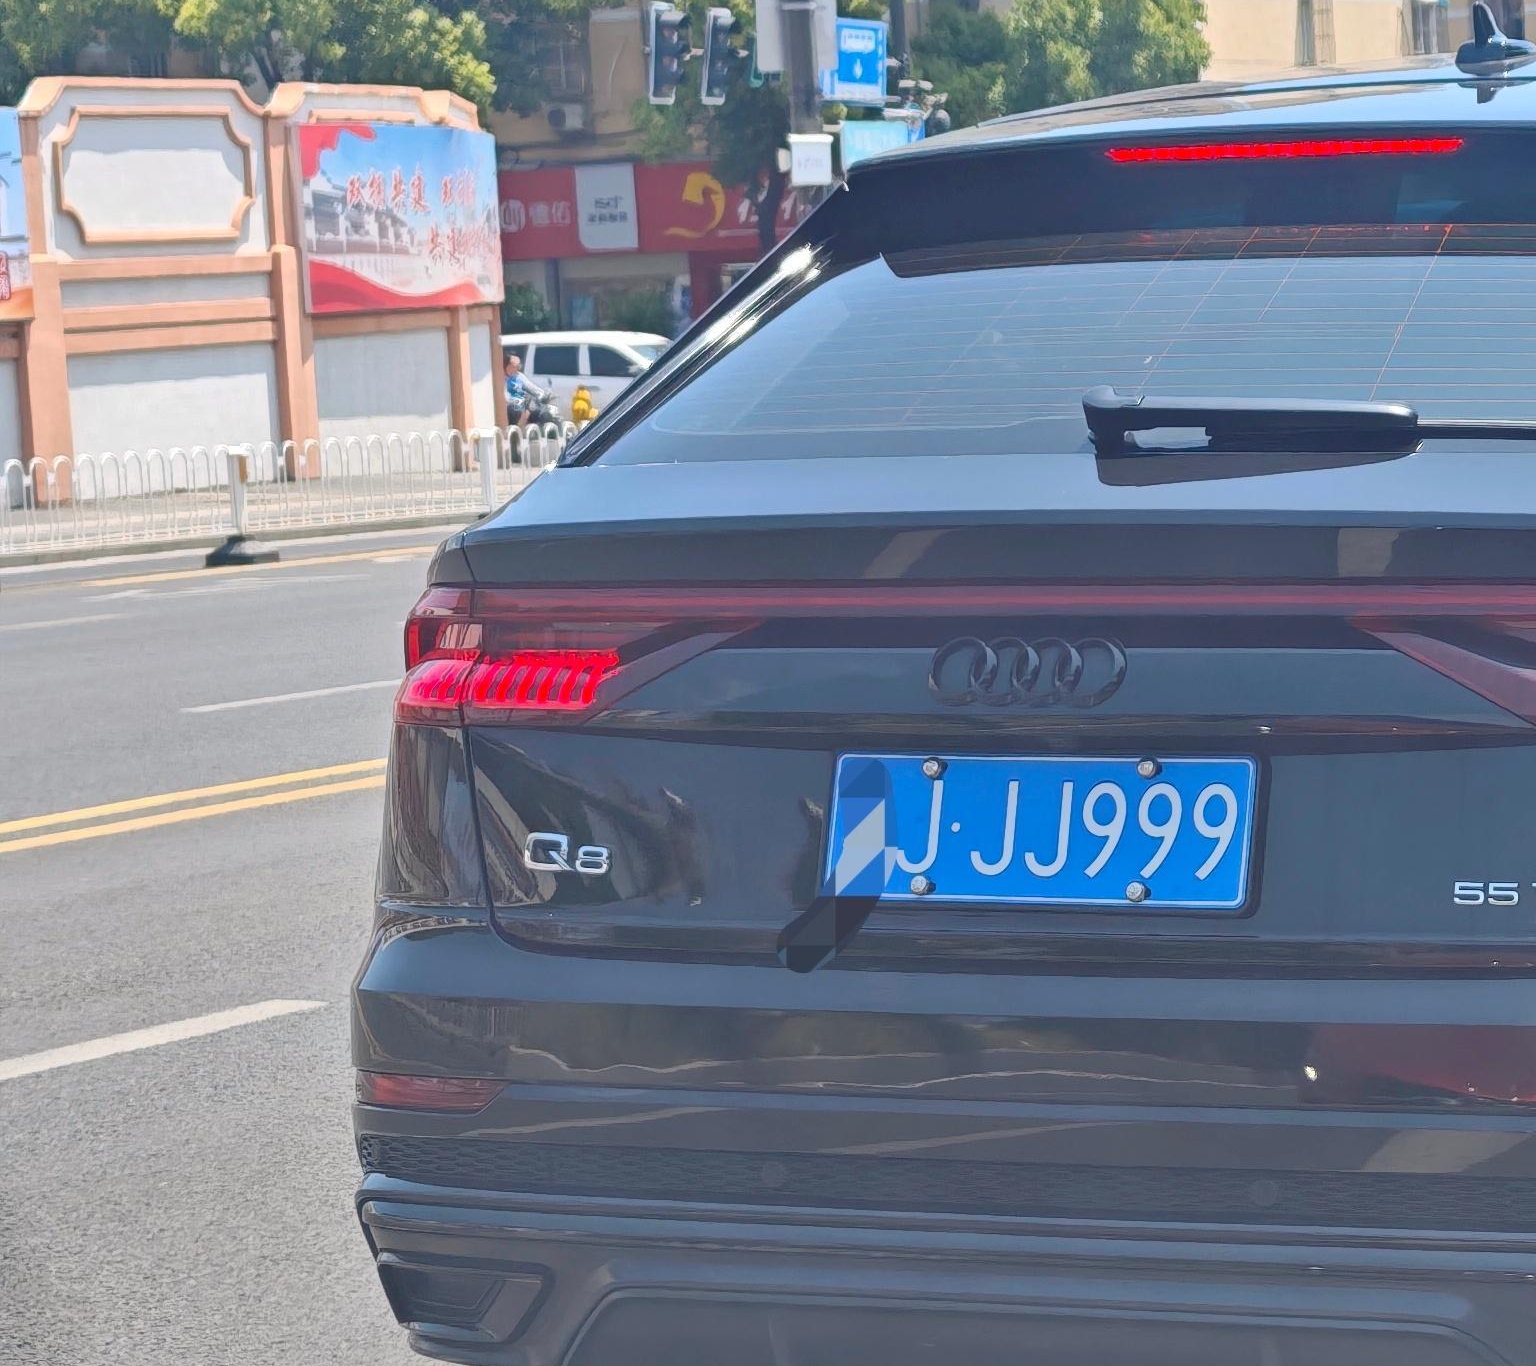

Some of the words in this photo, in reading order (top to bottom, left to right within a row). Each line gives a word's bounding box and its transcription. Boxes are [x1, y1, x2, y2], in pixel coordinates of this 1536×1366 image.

[836, 777, 1240, 883] J·JJ999
[524, 832, 609, 874] Q8
[1453, 881, 1519, 905] 55
